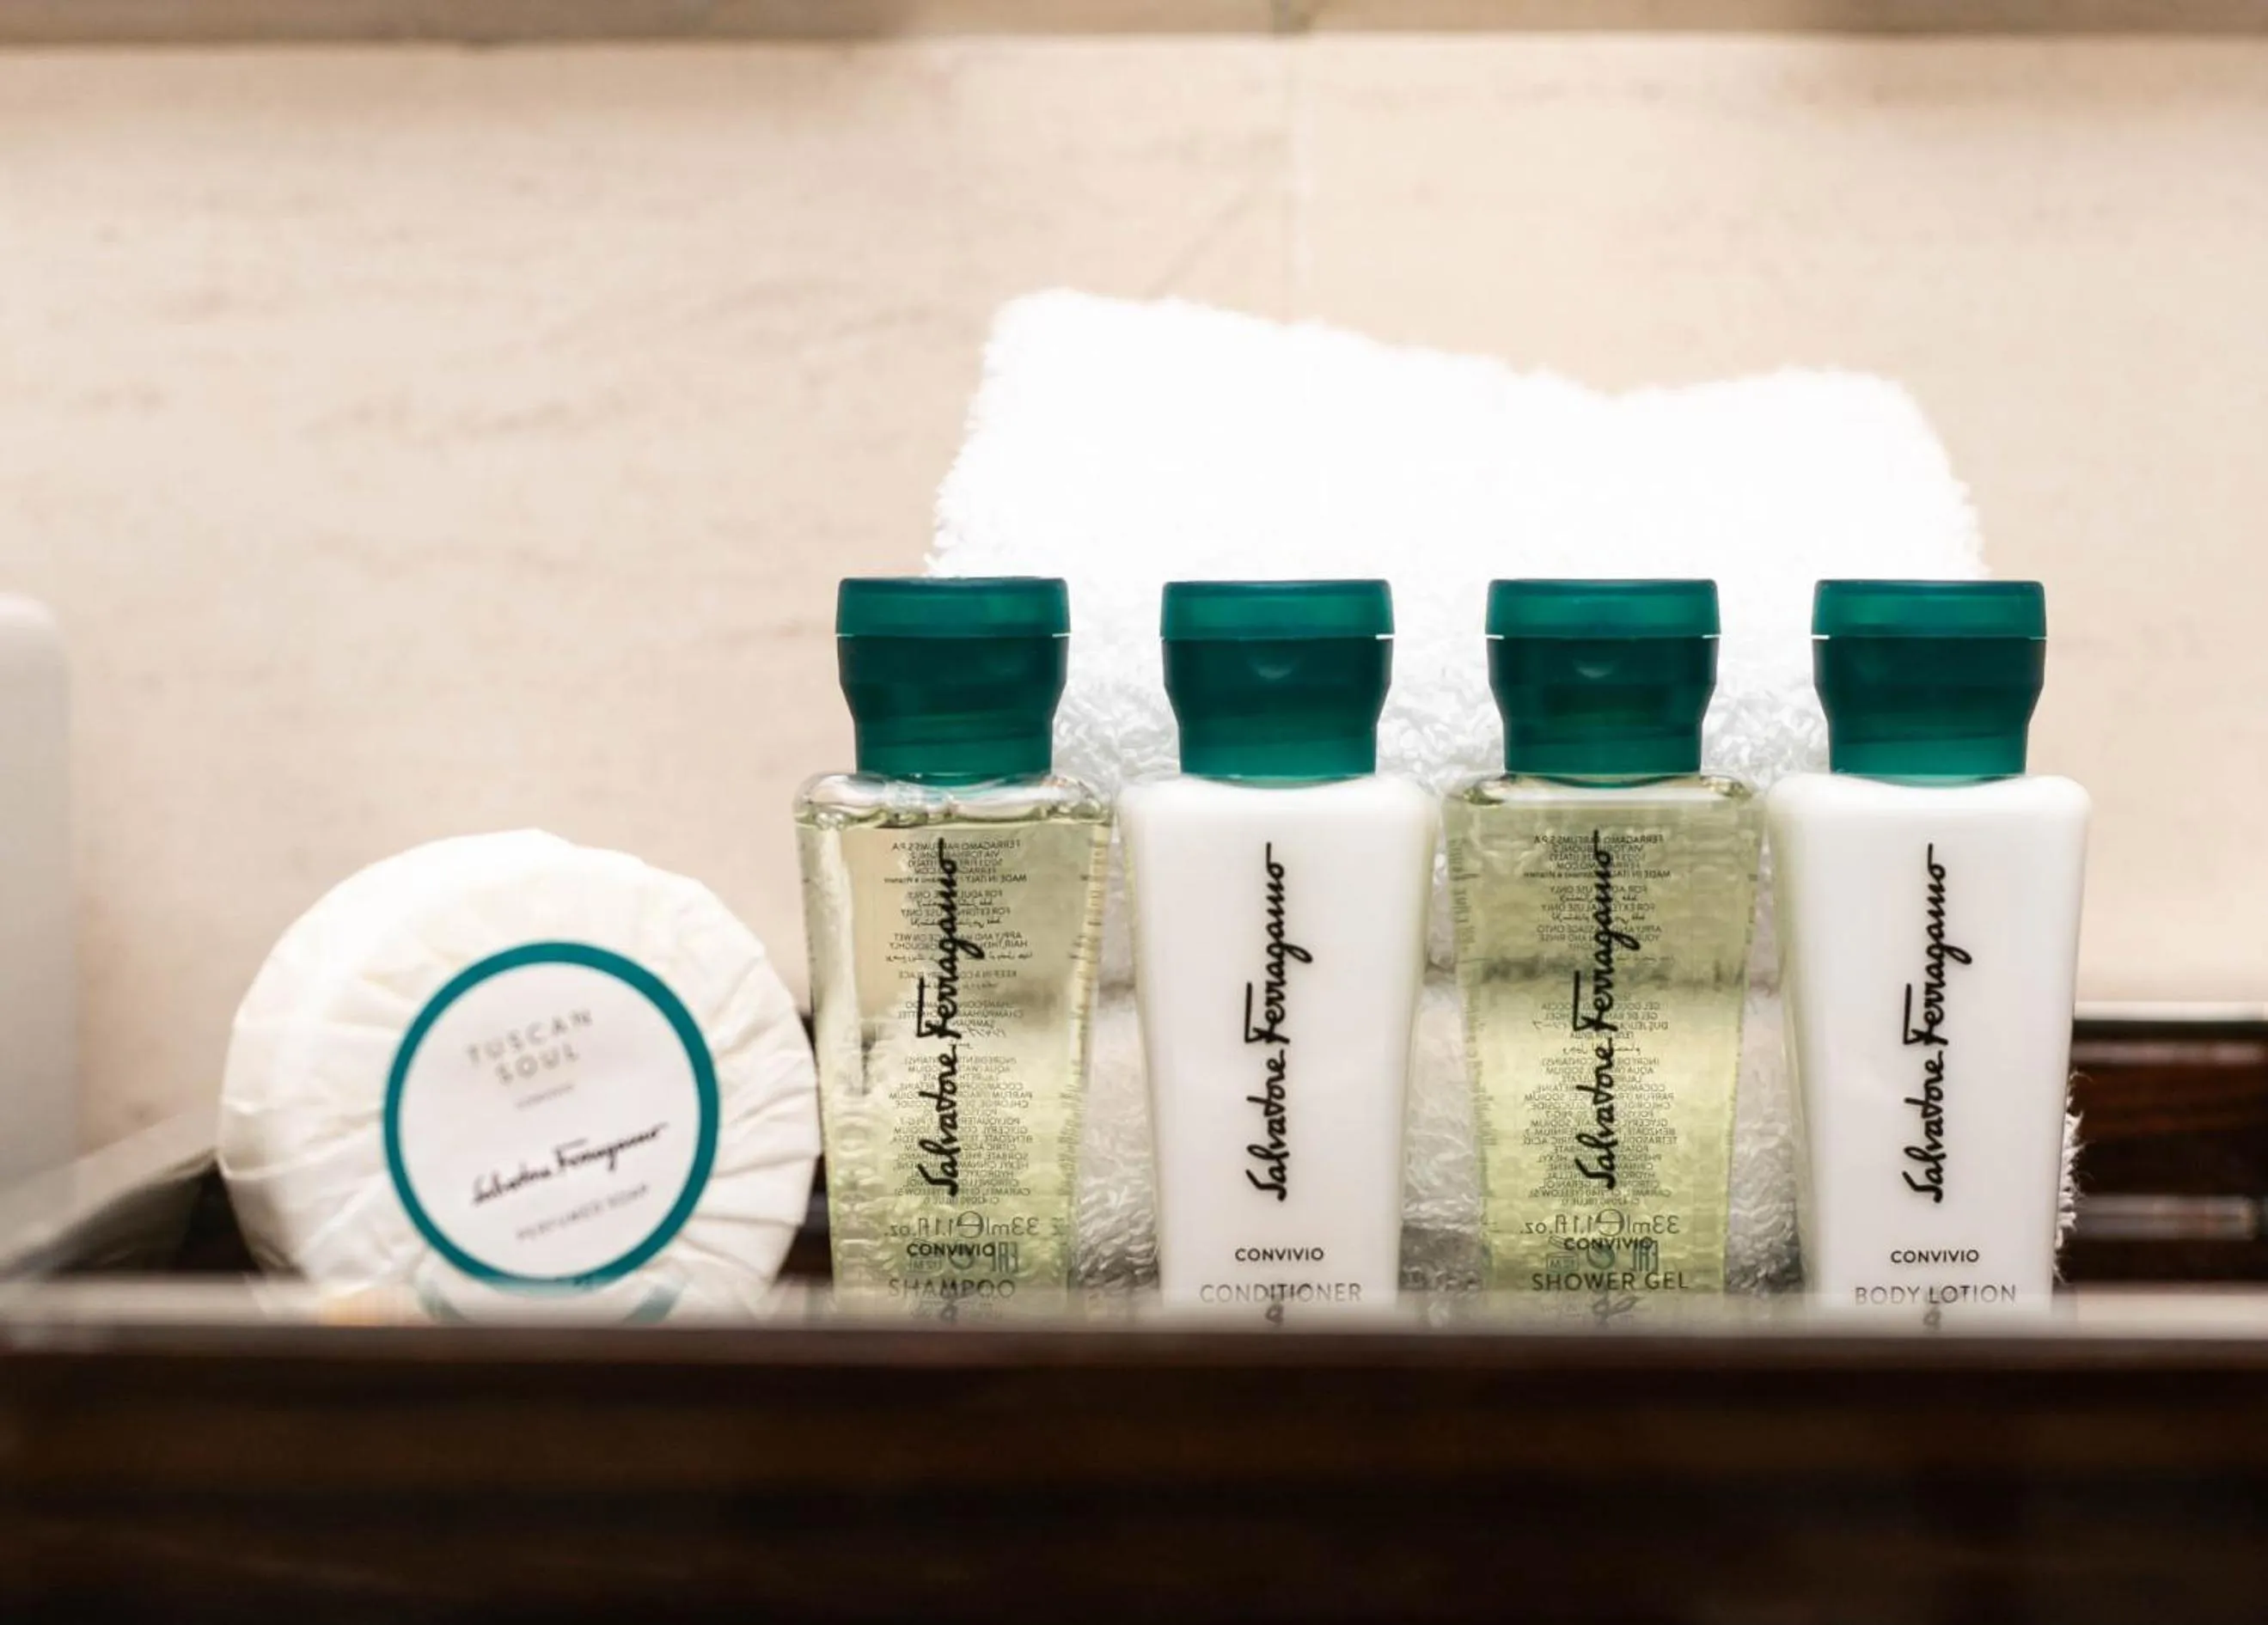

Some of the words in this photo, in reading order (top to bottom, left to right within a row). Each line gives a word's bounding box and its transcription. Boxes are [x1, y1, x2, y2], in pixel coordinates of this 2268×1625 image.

[915, 836, 985, 1039] Ferragamo
[1244, 841, 1314, 1044] Ferragamo
[1572, 829, 1641, 1032] Ferragamo
[1902, 842, 1973, 1046] Ferragamo
[466, 1009, 594, 1066] TUSCAN
[494, 1043, 581, 1085] SOUL
[917, 1045, 962, 1196] Salvatore
[1245, 1049, 1291, 1201] Salvatore
[1573, 1037, 1618, 1191] Salvatore
[1902, 1050, 1947, 1203] Salvatore
[906, 1243, 995, 1257] CONVIVIO
[1234, 1248, 1324, 1262] CONVIVIO
[1563, 1236, 1654, 1250] CONVIVIO
[1891, 1249, 1980, 1263] CONVIVIO
[888, 1278, 1017, 1298] SHAMPOO
[1200, 1283, 1362, 1303] CONDITIONER
[1531, 1272, 1635, 1291] SHOWER
[1644, 1271, 1689, 1290] GEL
[1855, 1286, 1921, 1305] BODY
[1929, 1285, 2017, 1304] LOTION
